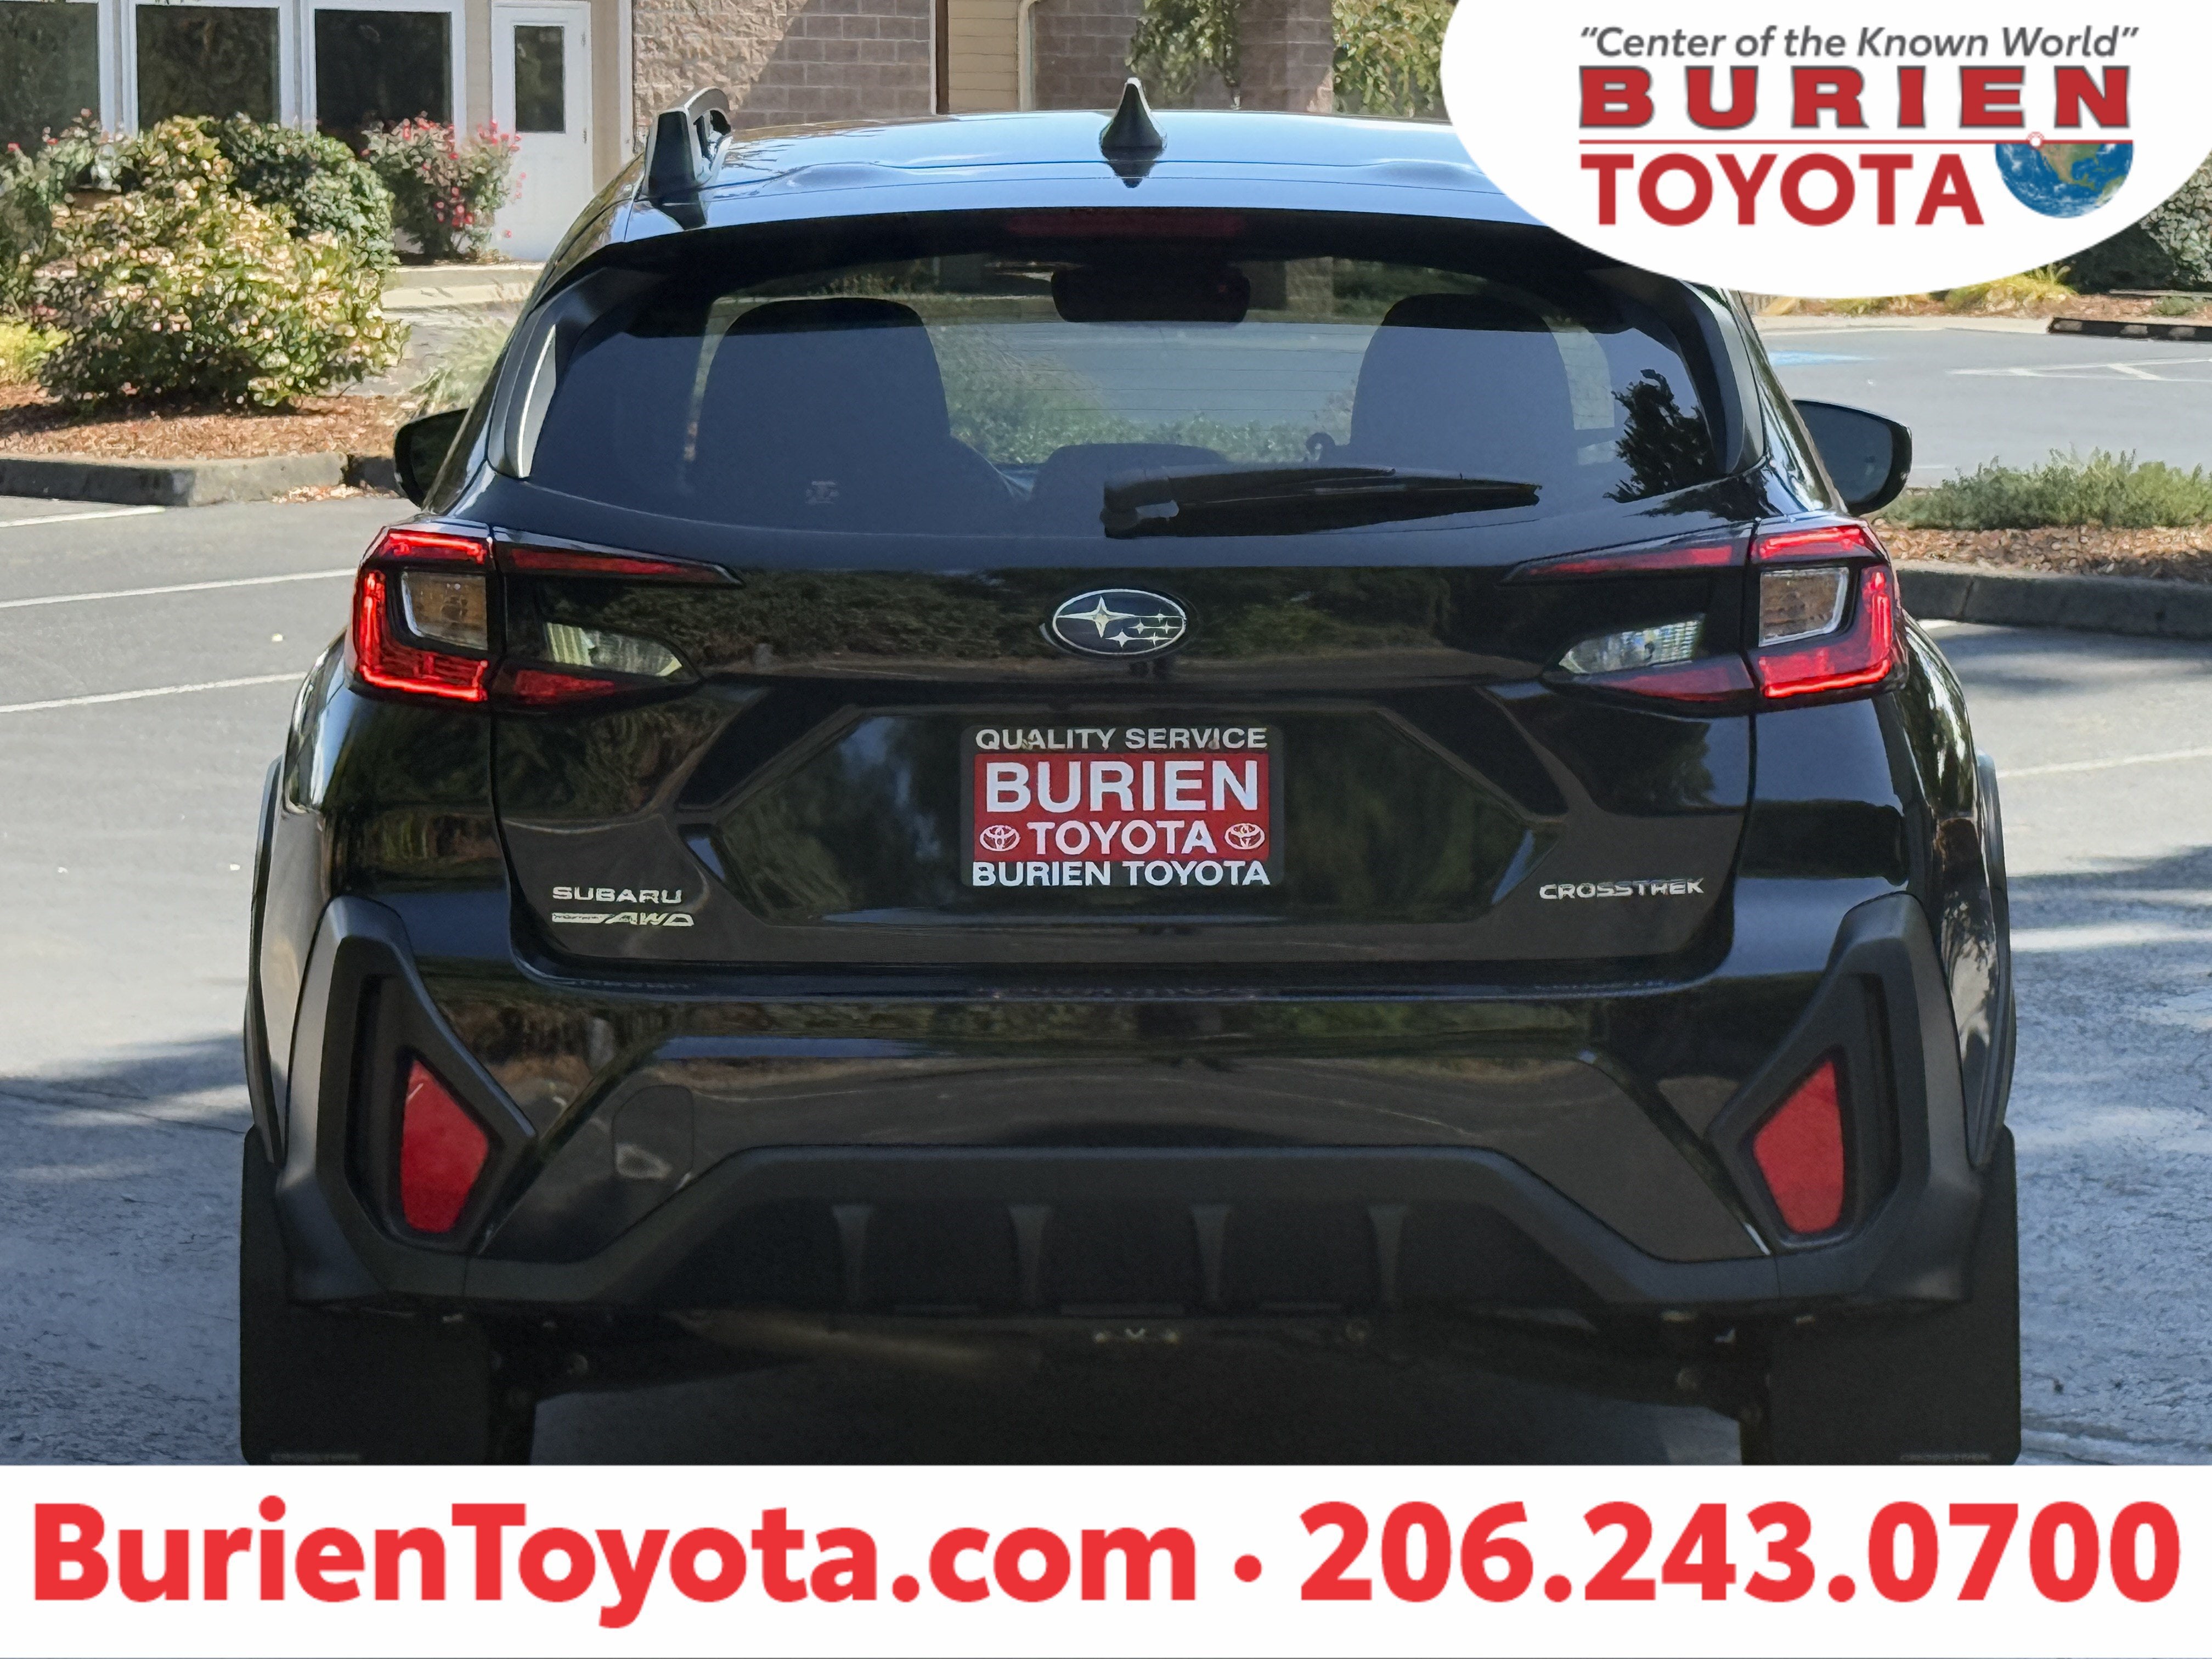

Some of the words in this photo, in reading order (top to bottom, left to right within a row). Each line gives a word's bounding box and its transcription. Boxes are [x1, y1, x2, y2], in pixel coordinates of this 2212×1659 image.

[975, 728, 1116, 751] QUALITY
[1125, 727, 1268, 749] SERVICE
[986, 760, 1258, 814] BURIEN
[1026, 820, 1217, 855] TOYOTA
[972, 861, 1111, 887] BURIEN
[1122, 860, 1271, 886] TOYOTA
[552, 887, 682, 903] SUBARU
[1539, 878, 1705, 900] CROSSTREK
[605, 912, 695, 927] AWD
